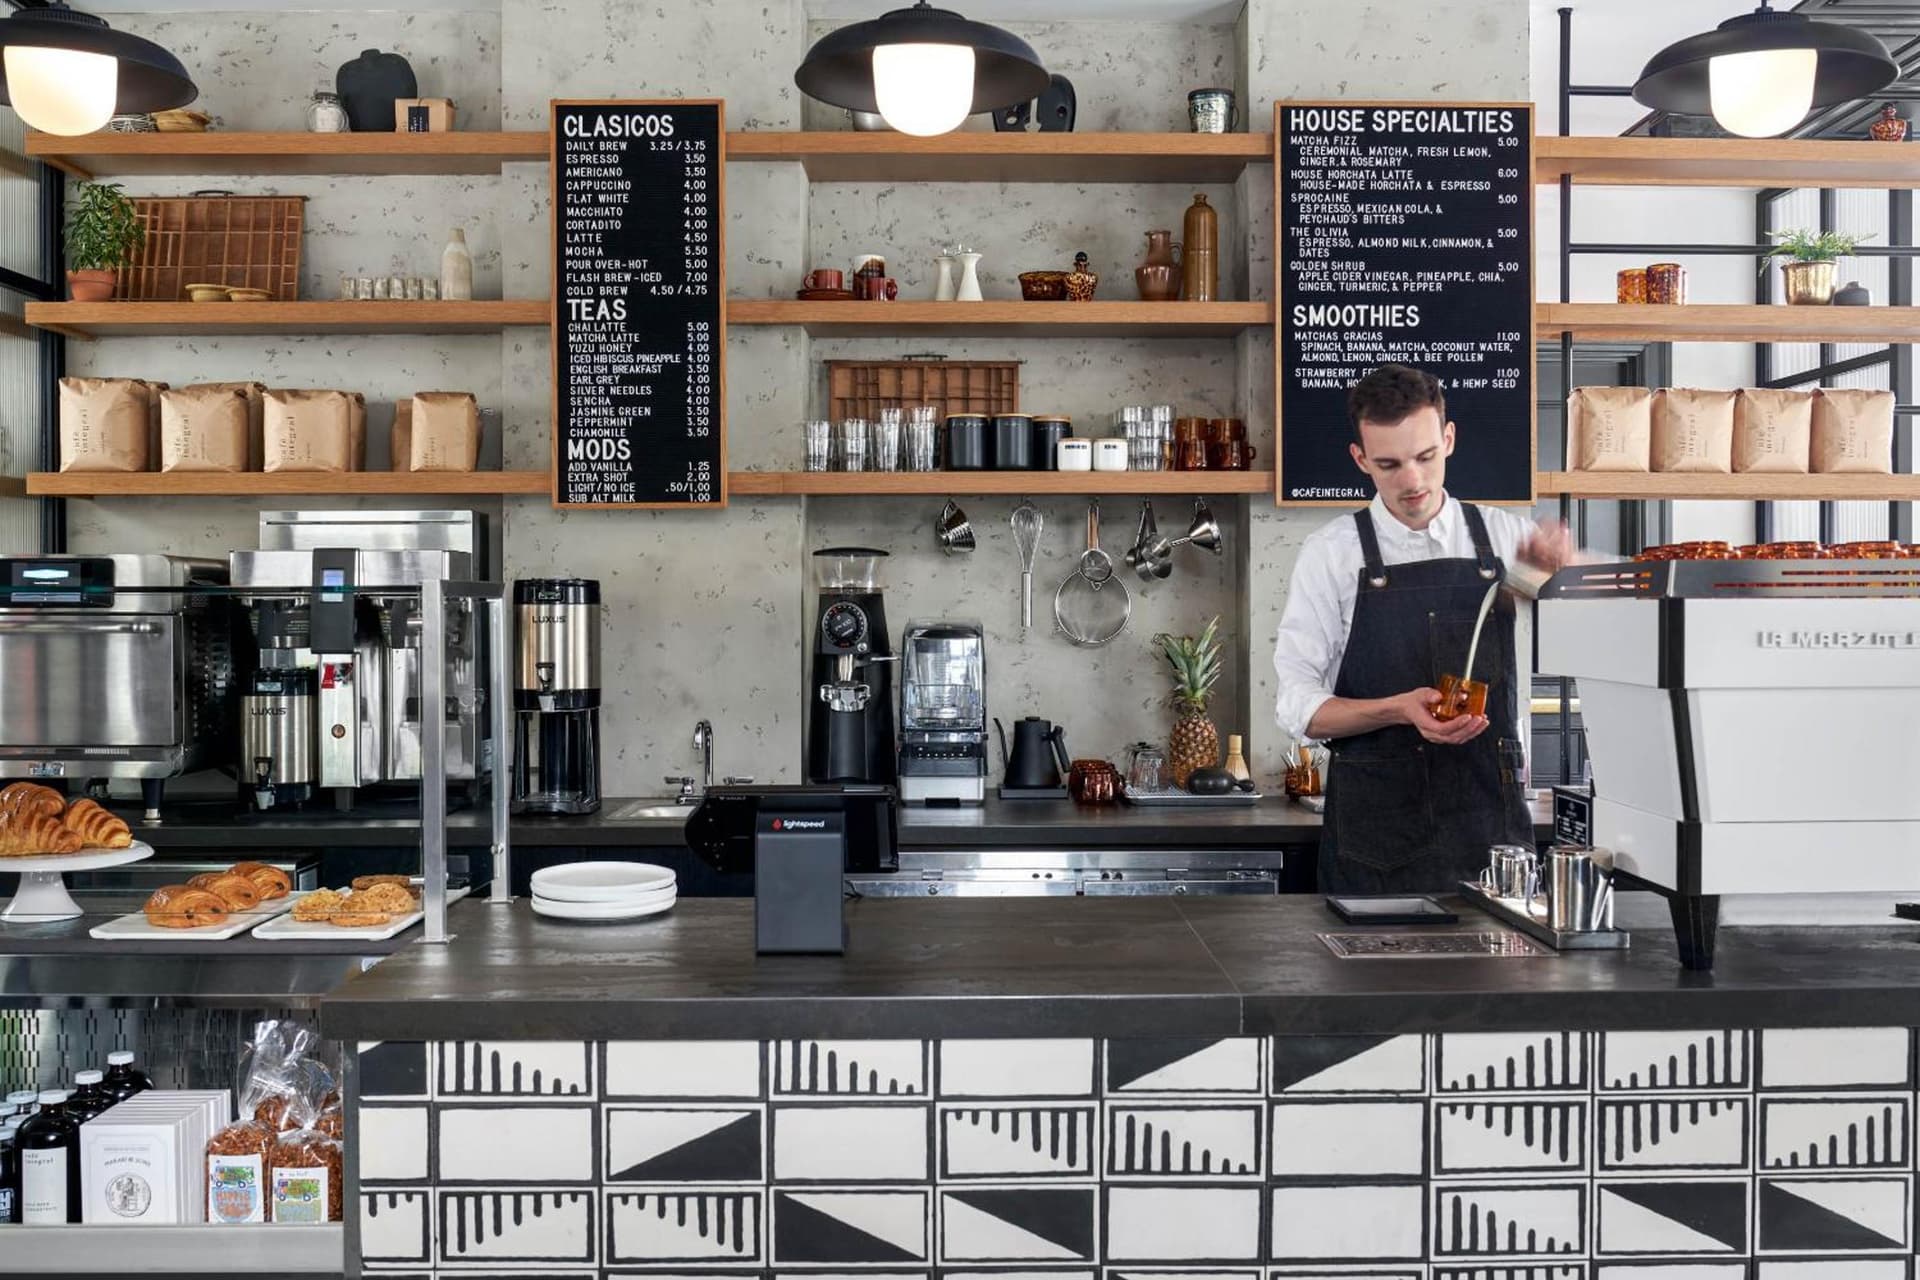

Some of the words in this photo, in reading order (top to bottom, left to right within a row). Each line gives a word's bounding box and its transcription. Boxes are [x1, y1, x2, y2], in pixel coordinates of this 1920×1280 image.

[563, 114, 674, 137] CLASICOS
[1290, 110, 1365, 133] HOUSE
[1372, 110, 1514, 133] SPECIALTIES
[566, 141, 594, 151] DAILY
[599, 141, 628, 151] BREW
[1290, 136, 1329, 146] MATCHA
[1333, 136, 1357, 146] FIZZ
[1497, 136, 1518, 146] 5.00
[1299, 146, 1363, 158] CEREMONIAL
[1417, 146, 1449, 158] FRESH
[566, 154, 619, 164] ESPRESSO
[684, 154, 706, 164] 3.50
[1351, 157, 1402, 167] ROSEMARY
[566, 167, 623, 177] AMERICANO
[684, 167, 706, 177] 3.50
[1290, 169, 1323, 180] HOUSE
[1327, 169, 1377, 180] HORCHATA
[1381, 169, 1413, 180] LATTE
[1497, 169, 1518, 180] 6.00
[566, 180, 632, 190] CAPPUCCINO
[684, 180, 707, 190] 4.00
[1299, 180, 1366, 191] HOUSE-MADE
[1370, 180, 1422, 191] HORCHATA
[1426, 180, 1434, 191] &
[1440, 180, 1491, 191] ESPRESSO
[567, 193, 592, 203] FLAT
[598, 193, 630, 203] WHITE
[683, 193, 707, 203] 4.00
[1290, 193, 1350, 204] SPROCAINE
[1497, 193, 1518, 204] 5.00
[566, 207, 623, 217] MACCHIATO
[683, 207, 707, 217] 4.00
[1356, 204, 1402, 214] MEXICAN
[1363, 214, 1405, 224] BITTERS
[566, 220, 622, 230] CORTADITO
[683, 220, 708, 230] 4.00
[1290, 227, 1310, 237] THE
[1314, 227, 1349, 237] OLIVIA
[1497, 227, 1518, 237] 5.00
[566, 233, 603, 243] LATTE
[683, 233, 708, 243] 4.50
[1357, 238, 1399, 249] ALMOND
[565, 246, 604, 257] MOCHA
[684, 246, 708, 257] 5.50
[1299, 248, 1330, 258] DATES
[565, 259, 592, 270] POUR
[685, 259, 708, 270] 5.00
[1289, 261, 1328, 271] GOLDEN
[1330, 261, 1366, 271] SHRUB
[1498, 261, 1519, 271] 5.00
[566, 273, 600, 283] FLASH
[685, 273, 708, 283] 7.00
[1298, 271, 1329, 283] APPLE
[1332, 271, 1363, 283] CIDER
[567, 286, 594, 296] COLD
[600, 286, 628, 296] BREW
[1403, 282, 1443, 293] PEPPER
[566, 299, 627, 321] TEAS
[1292, 304, 1421, 328] SMOOTHIES
[568, 322, 591, 332] CHAI
[593, 322, 626, 332] LATTE
[687, 322, 709, 332] 5.00
[568, 333, 607, 343] MATCHA
[610, 333, 640, 343] LATTE
[687, 333, 709, 343] 5.00
[1294, 331, 1339, 342] MATCHAS
[1343, 331, 1383, 342] GRACIAS
[1496, 331, 1521, 342] 11.00
[568, 343, 595, 353] YUZU
[599, 343, 633, 353] HONEY
[687, 343, 710, 353] 4.00
[1431, 342, 1475, 353] COCONUT
[570, 354, 591, 364] ICED
[593, 354, 634, 364] HIBISCUS
[636, 354, 681, 364] PINEAPPLE
[686, 354, 710, 364] 4.00
[1424, 352, 1443, 364] BEE
[1447, 352, 1484, 364] POLLEN
[570, 364, 608, 374] ENGLISH
[612, 364, 663, 374] BREAKFAST
[687, 364, 709, 374] 3.50
[1294, 367, 1356, 379] STRAWBERRY
[1496, 367, 1520, 379] 11.00
[570, 375, 594, 385] EARL
[596, 375, 620, 385] GREY
[686, 375, 710, 385] 4.00
[1452, 378, 1459, 390] &
[1462, 378, 1488, 390] HEMP
[1492, 378, 1517, 390] SEED
[570, 385, 605, 395] SILVER
[610, 385, 652, 395] NEEDLES
[686, 385, 710, 395] 4.00
[570, 396, 611, 406] SENCHA
[686, 396, 710, 406] 4.00
[570, 407, 615, 417] JASMINE
[618, 407, 651, 417] GREEN
[686, 407, 710, 417] 3.50
[570, 417, 633, 427] PEPPERMINT
[686, 417, 709, 427] 3.50
[570, 427, 626, 437] CHAMOMILE
[687, 427, 709, 437] 3.50
[567, 439, 632, 461] MODS
[568, 462, 587, 472] ADD
[590, 462, 633, 472] VANILLA
[688, 462, 710, 472] 1.25
[567, 472, 598, 482] EXTRA
[603, 472, 628, 482] SHOT
[686, 472, 710, 482] 2.00
[620, 483, 636, 493] ICE
[1291, 488, 1367, 498] @CAFEINTEGRAL
[568, 493, 588, 503] SUB
[592, 493, 608, 503] ALT
[612, 493, 636, 503] MILK
[688, 493, 710, 503] 1.00
[532, 615, 566, 624] LUXUS
[250, 707, 288, 716] LUXUS
[783, 819, 825, 830] lightspeed
